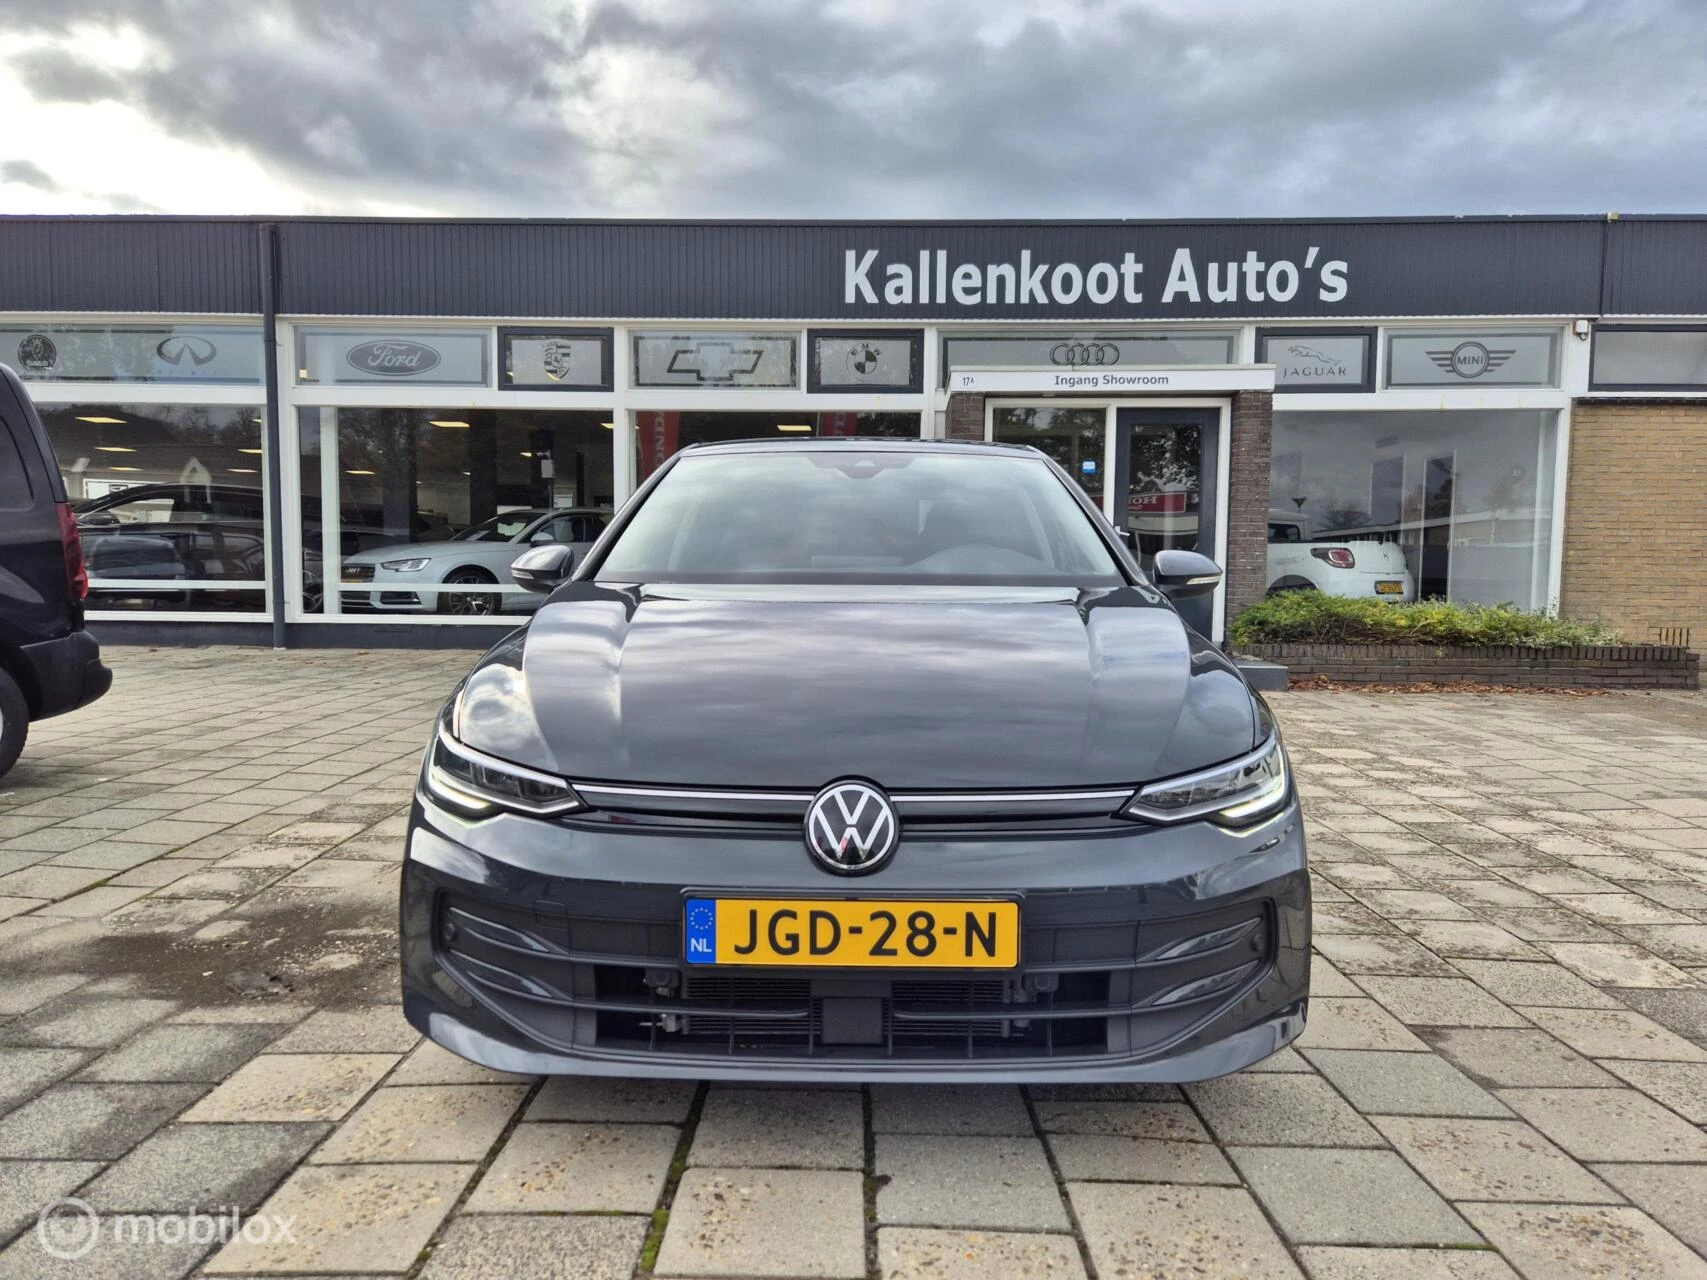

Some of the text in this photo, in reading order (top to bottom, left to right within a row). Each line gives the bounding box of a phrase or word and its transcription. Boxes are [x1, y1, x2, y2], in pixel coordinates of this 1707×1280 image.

[844, 246, 1349, 305] Kallenkoot Auto's
[367, 344, 423, 367] Ford
[1456, 356, 1484, 365] MINI
[1054, 374, 1169, 387] Ingang Showroom
[1283, 366, 1347, 378] JAGUAR
[653, 411, 666, 469] OND
[734, 909, 997, 957] JGD-28-N
[690, 938, 712, 953] NL
